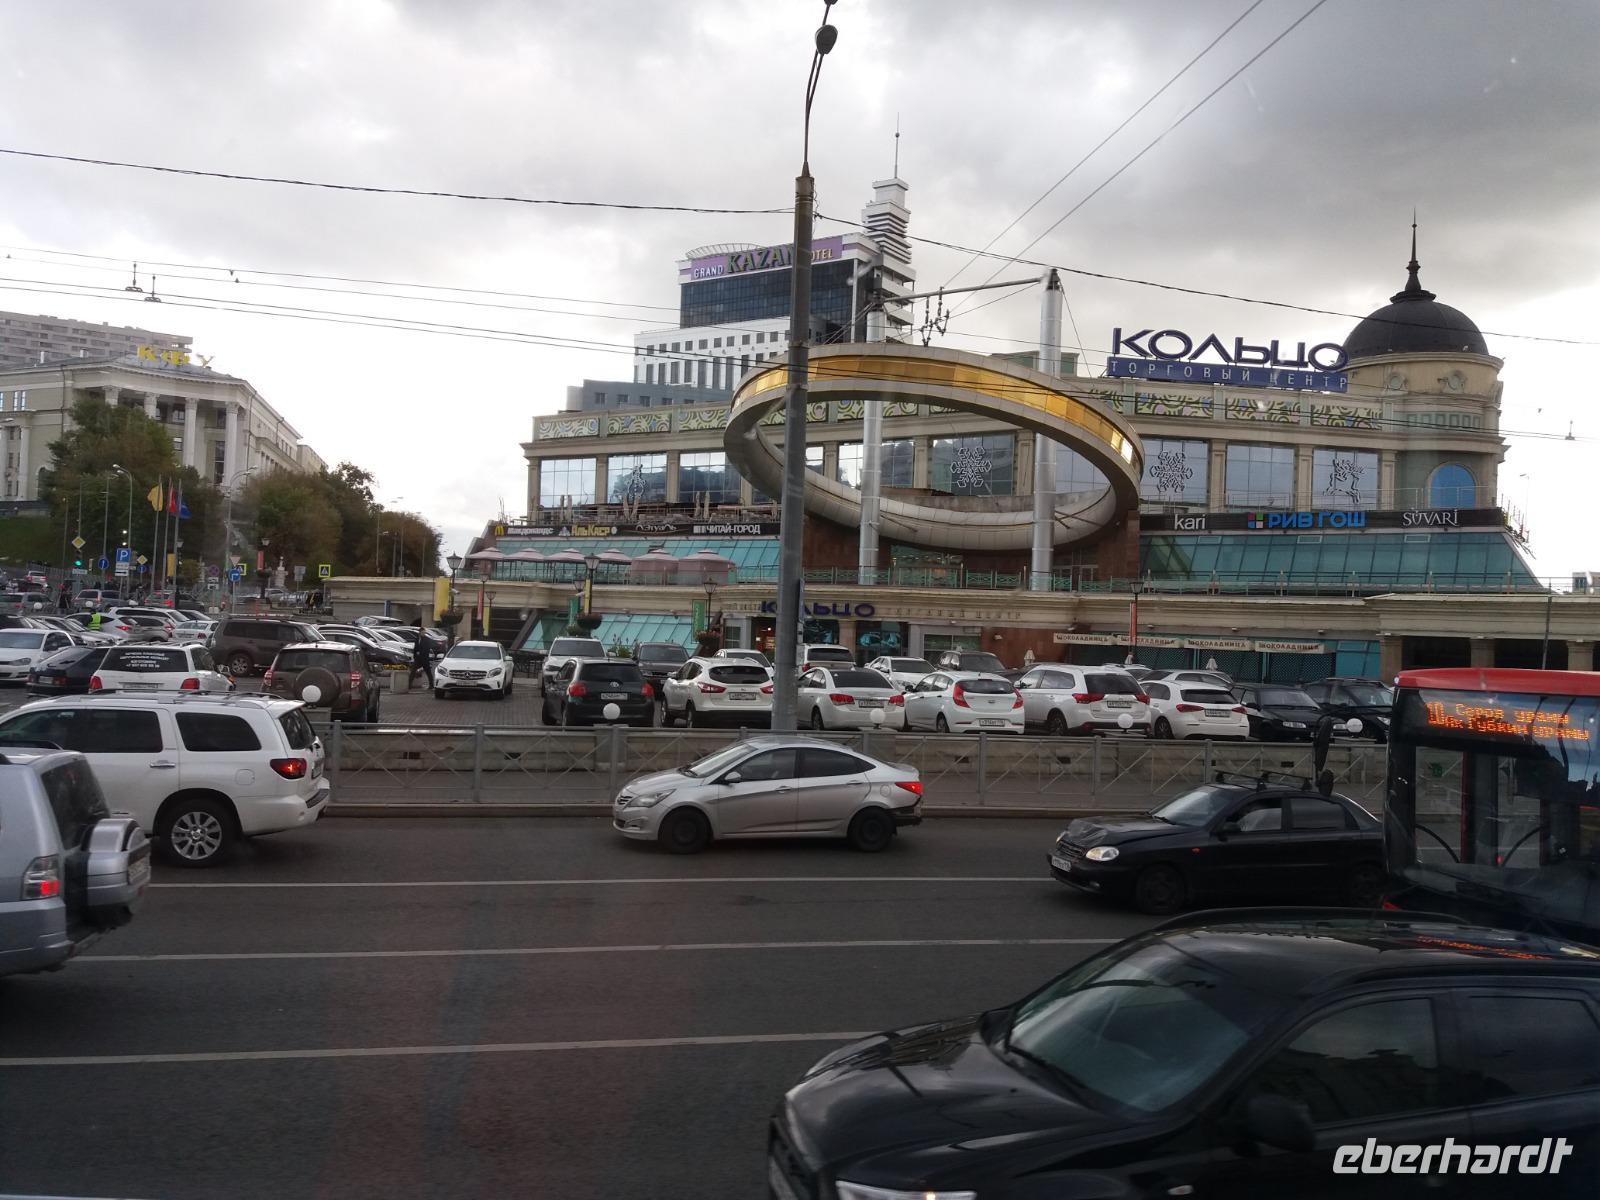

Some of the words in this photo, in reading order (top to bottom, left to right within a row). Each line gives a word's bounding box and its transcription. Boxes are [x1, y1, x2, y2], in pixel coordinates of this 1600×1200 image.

[693, 265, 723, 279] GRAND
[1112, 327, 1348, 372] КОЛЬЦО
[1111, 361, 1250, 381] ТОРГОВЫЙ
[1269, 370, 1347, 389] ЦЕНТР
[706, 522, 761, 535] ЧИТАЙ-ГОРОД
[1174, 514, 1206, 530] kari
[1268, 511, 1313, 529] РИВ
[1318, 511, 1366, 529] ГОШ
[761, 601, 875, 618] КЬЦО
